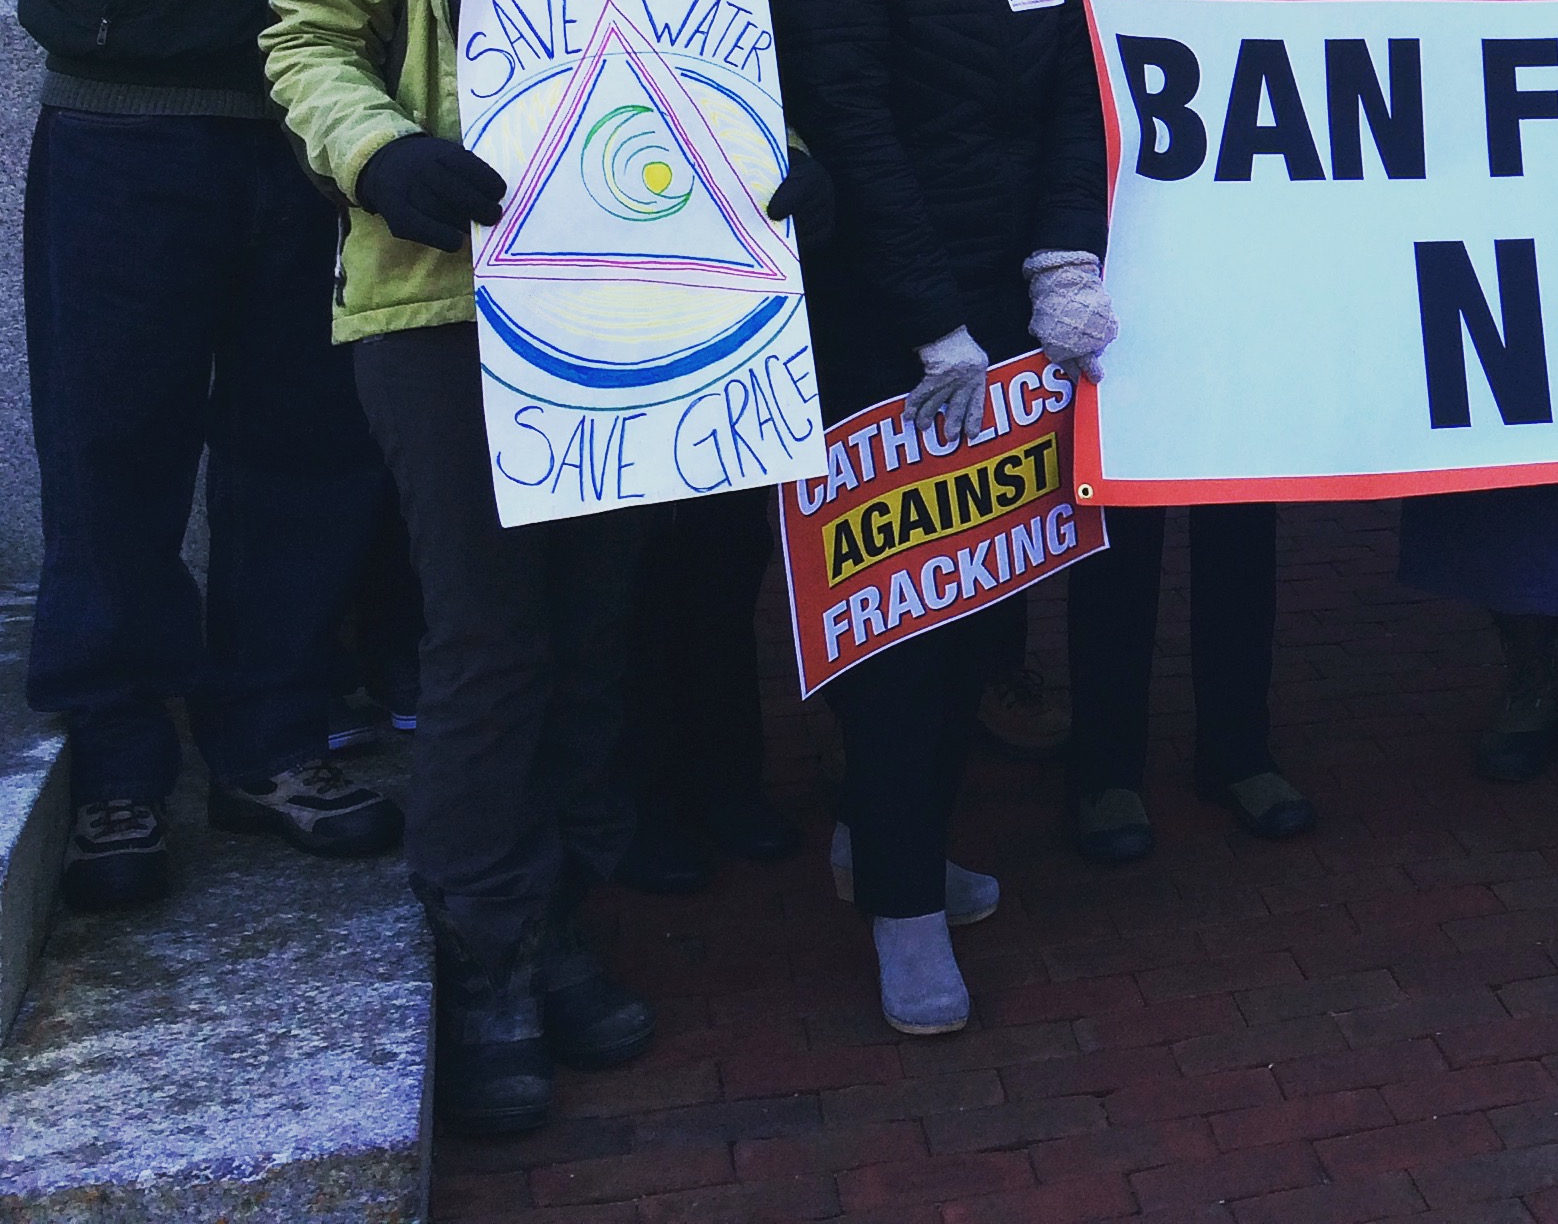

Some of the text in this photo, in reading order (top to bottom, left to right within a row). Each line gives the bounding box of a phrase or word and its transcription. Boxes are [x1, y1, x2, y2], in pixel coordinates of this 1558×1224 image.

[1115, 33, 1427, 182] BAN
[496, 346, 818, 502] SAVE GRACE
[822, 502, 1077, 663] FRACKING
[831, 442, 1053, 580] AGAINST
